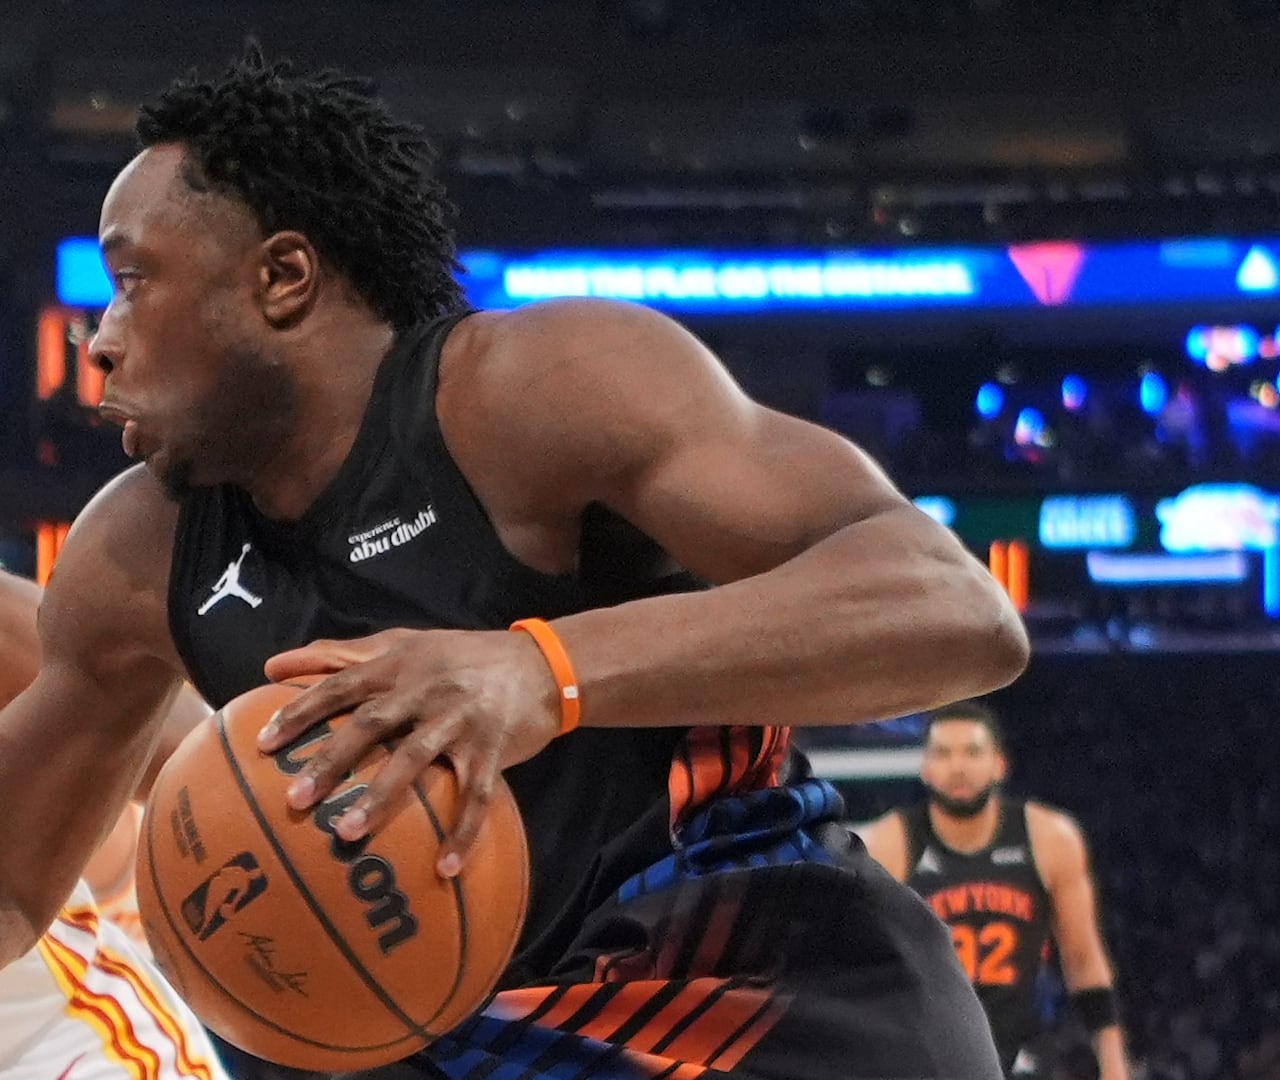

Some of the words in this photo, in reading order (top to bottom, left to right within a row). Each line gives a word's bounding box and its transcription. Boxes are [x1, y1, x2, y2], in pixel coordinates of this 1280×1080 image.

[347, 517, 401, 544] experience
[349, 536, 391, 563] abu
[391, 503, 436, 546] dhabi
